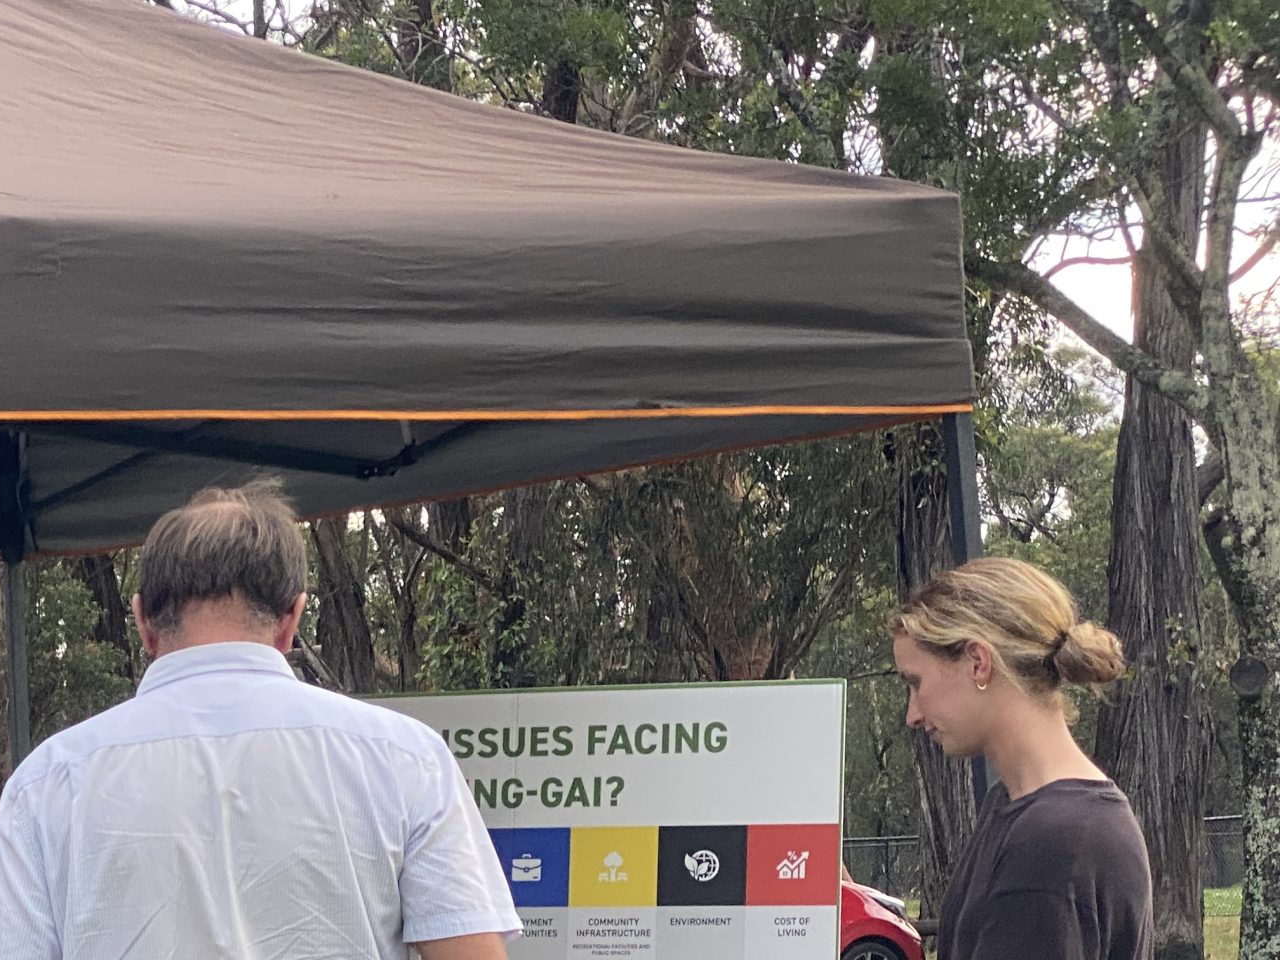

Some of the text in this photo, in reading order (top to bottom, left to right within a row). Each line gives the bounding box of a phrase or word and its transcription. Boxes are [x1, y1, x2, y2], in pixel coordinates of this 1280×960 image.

[442, 722, 728, 758] ISSUES FACING
[466, 776, 625, 809] NG-GAI?
[588, 918, 640, 927] COMMUNITY
[670, 917, 732, 926] ENVIRONMENT
[774, 917, 810, 926] COST OF
[576, 928, 652, 938] INFRASTRUCTURE
[778, 928, 807, 937] LIVING
